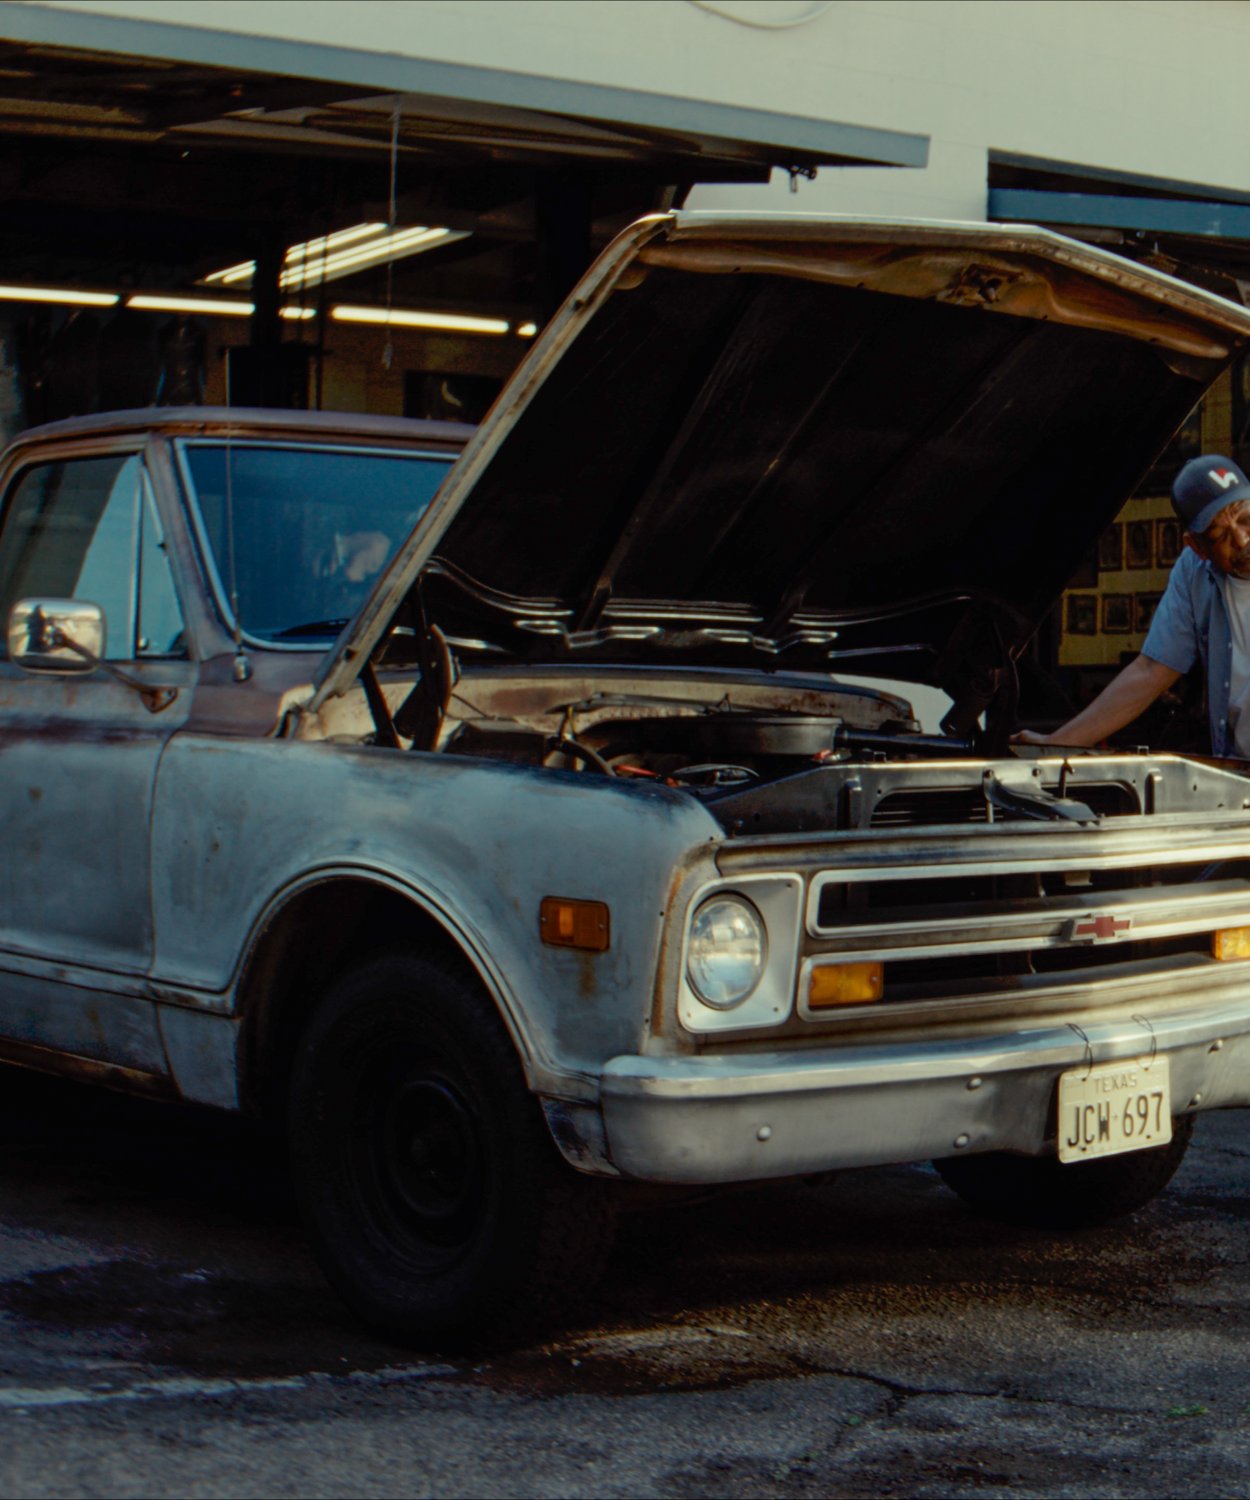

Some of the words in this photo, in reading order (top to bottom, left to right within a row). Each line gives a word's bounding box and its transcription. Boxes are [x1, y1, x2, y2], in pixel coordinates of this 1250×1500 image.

[1095, 1074, 1137, 1092] TEXAS
[1068, 1102, 1110, 1147] JCW
[1123, 1093, 1163, 1137] 697
